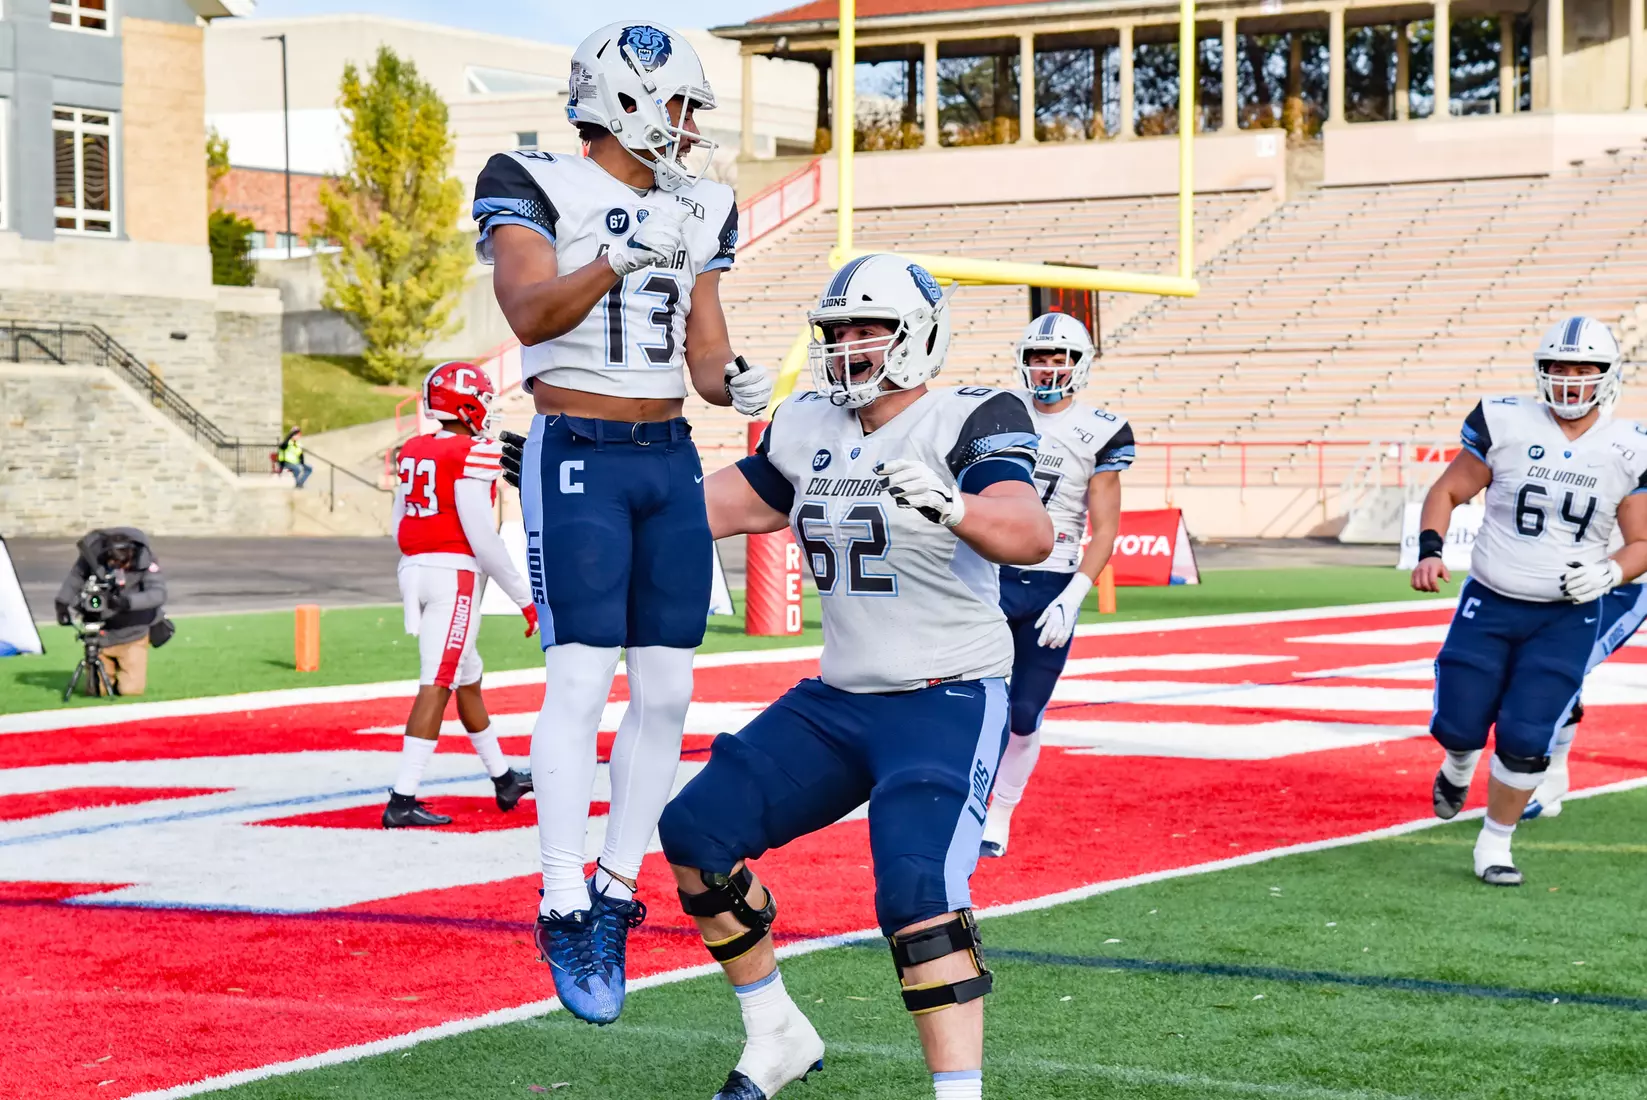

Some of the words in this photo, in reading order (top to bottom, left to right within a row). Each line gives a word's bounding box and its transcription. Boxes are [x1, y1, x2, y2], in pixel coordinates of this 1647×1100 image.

[609, 214, 626, 229] 67
[604, 272, 682, 369] 13
[822, 298, 847, 308] LIONS
[455, 368, 477, 395] C
[813, 454, 830, 467] 67
[1530, 447, 1543, 458] 67
[399, 456, 439, 517] 23
[559, 460, 585, 494] C
[1033, 469, 1065, 508] 7
[1526, 464, 1598, 489] COLUMBIA
[1513, 481, 1600, 546] 64
[795, 501, 899, 597] 62
[1112, 534, 1171, 557] YOTA
[528, 530, 546, 605] LIONS
[785, 542, 801, 633] RED
[446, 595, 471, 650] CORNELL
[1462, 596, 1482, 619] C
[968, 758, 990, 827] LIONS
